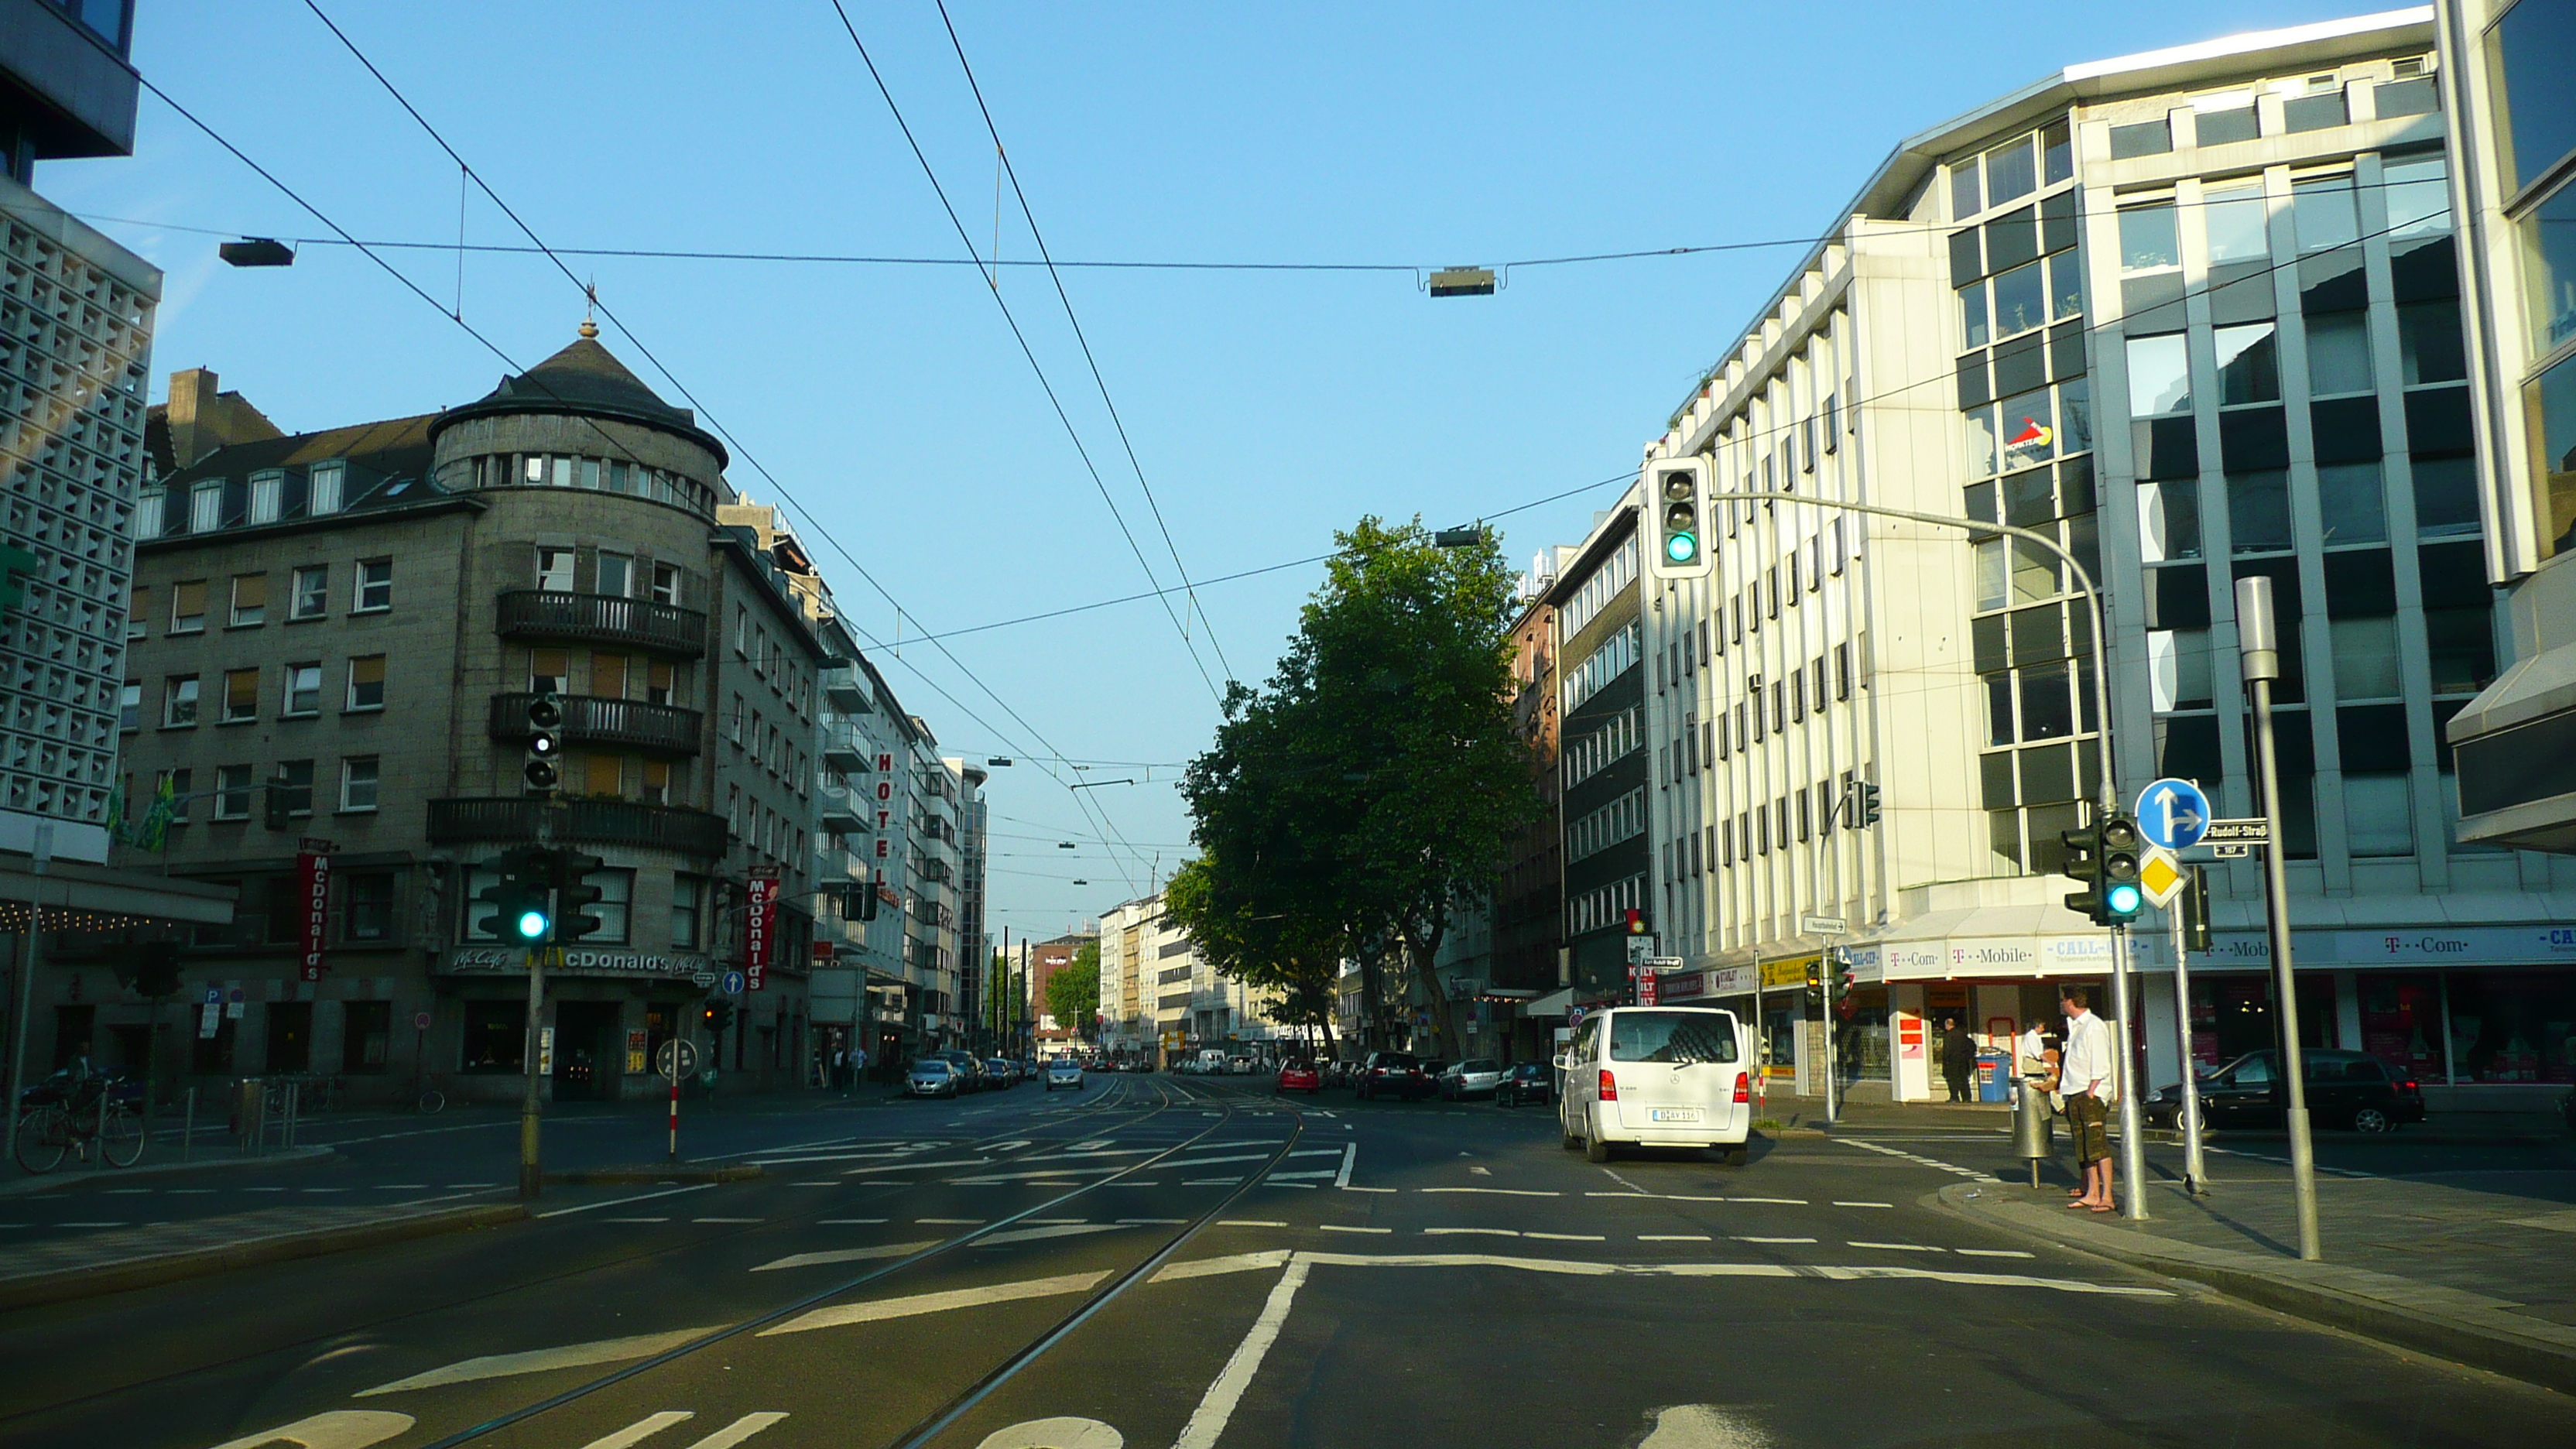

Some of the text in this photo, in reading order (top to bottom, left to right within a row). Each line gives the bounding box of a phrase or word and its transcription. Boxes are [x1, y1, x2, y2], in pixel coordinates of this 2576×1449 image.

[876, 754, 891, 887] HOTEL
[2204, 825, 2269, 837] -Rudolf-Straß
[307, 856, 329, 980] McDonald's
[748, 880, 765, 989] McDonald's
[2422, 937, 2464, 953] Com
[1911, 951, 1936, 966] Com
[1980, 948, 2027, 964] Mobile
[208, 990, 218, 1002] P
